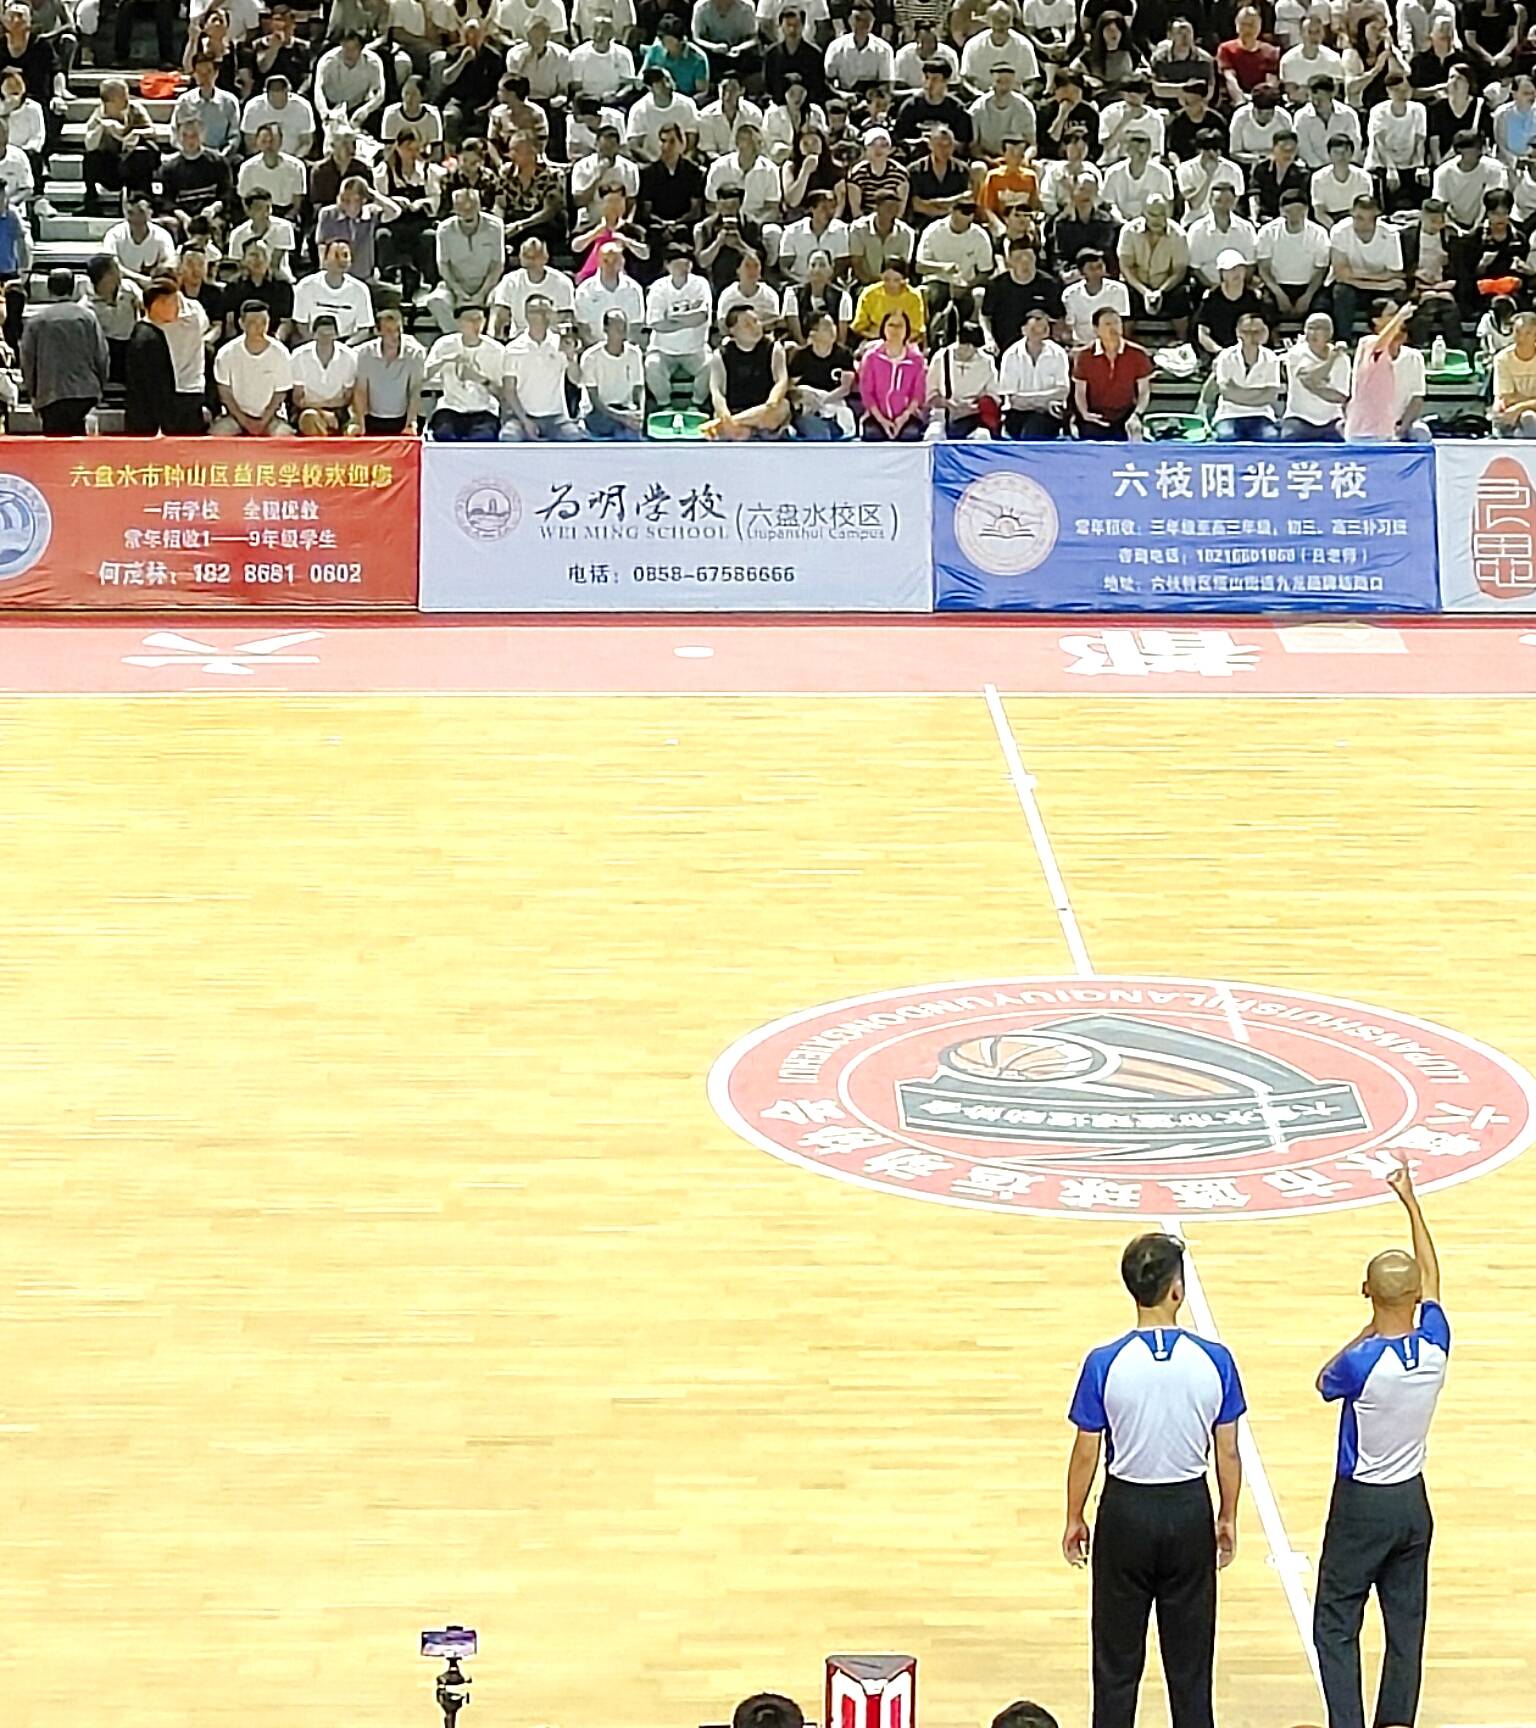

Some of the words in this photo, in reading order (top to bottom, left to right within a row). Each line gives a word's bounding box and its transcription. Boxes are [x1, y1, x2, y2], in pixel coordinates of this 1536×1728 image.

[69, 463, 393, 489] 六盘水市钟山区益民学校欢迎您
[1112, 460, 1368, 500] 六枝阳光学校
[583, 525, 639, 541] MING
[645, 525, 729, 541] SCHOOL
